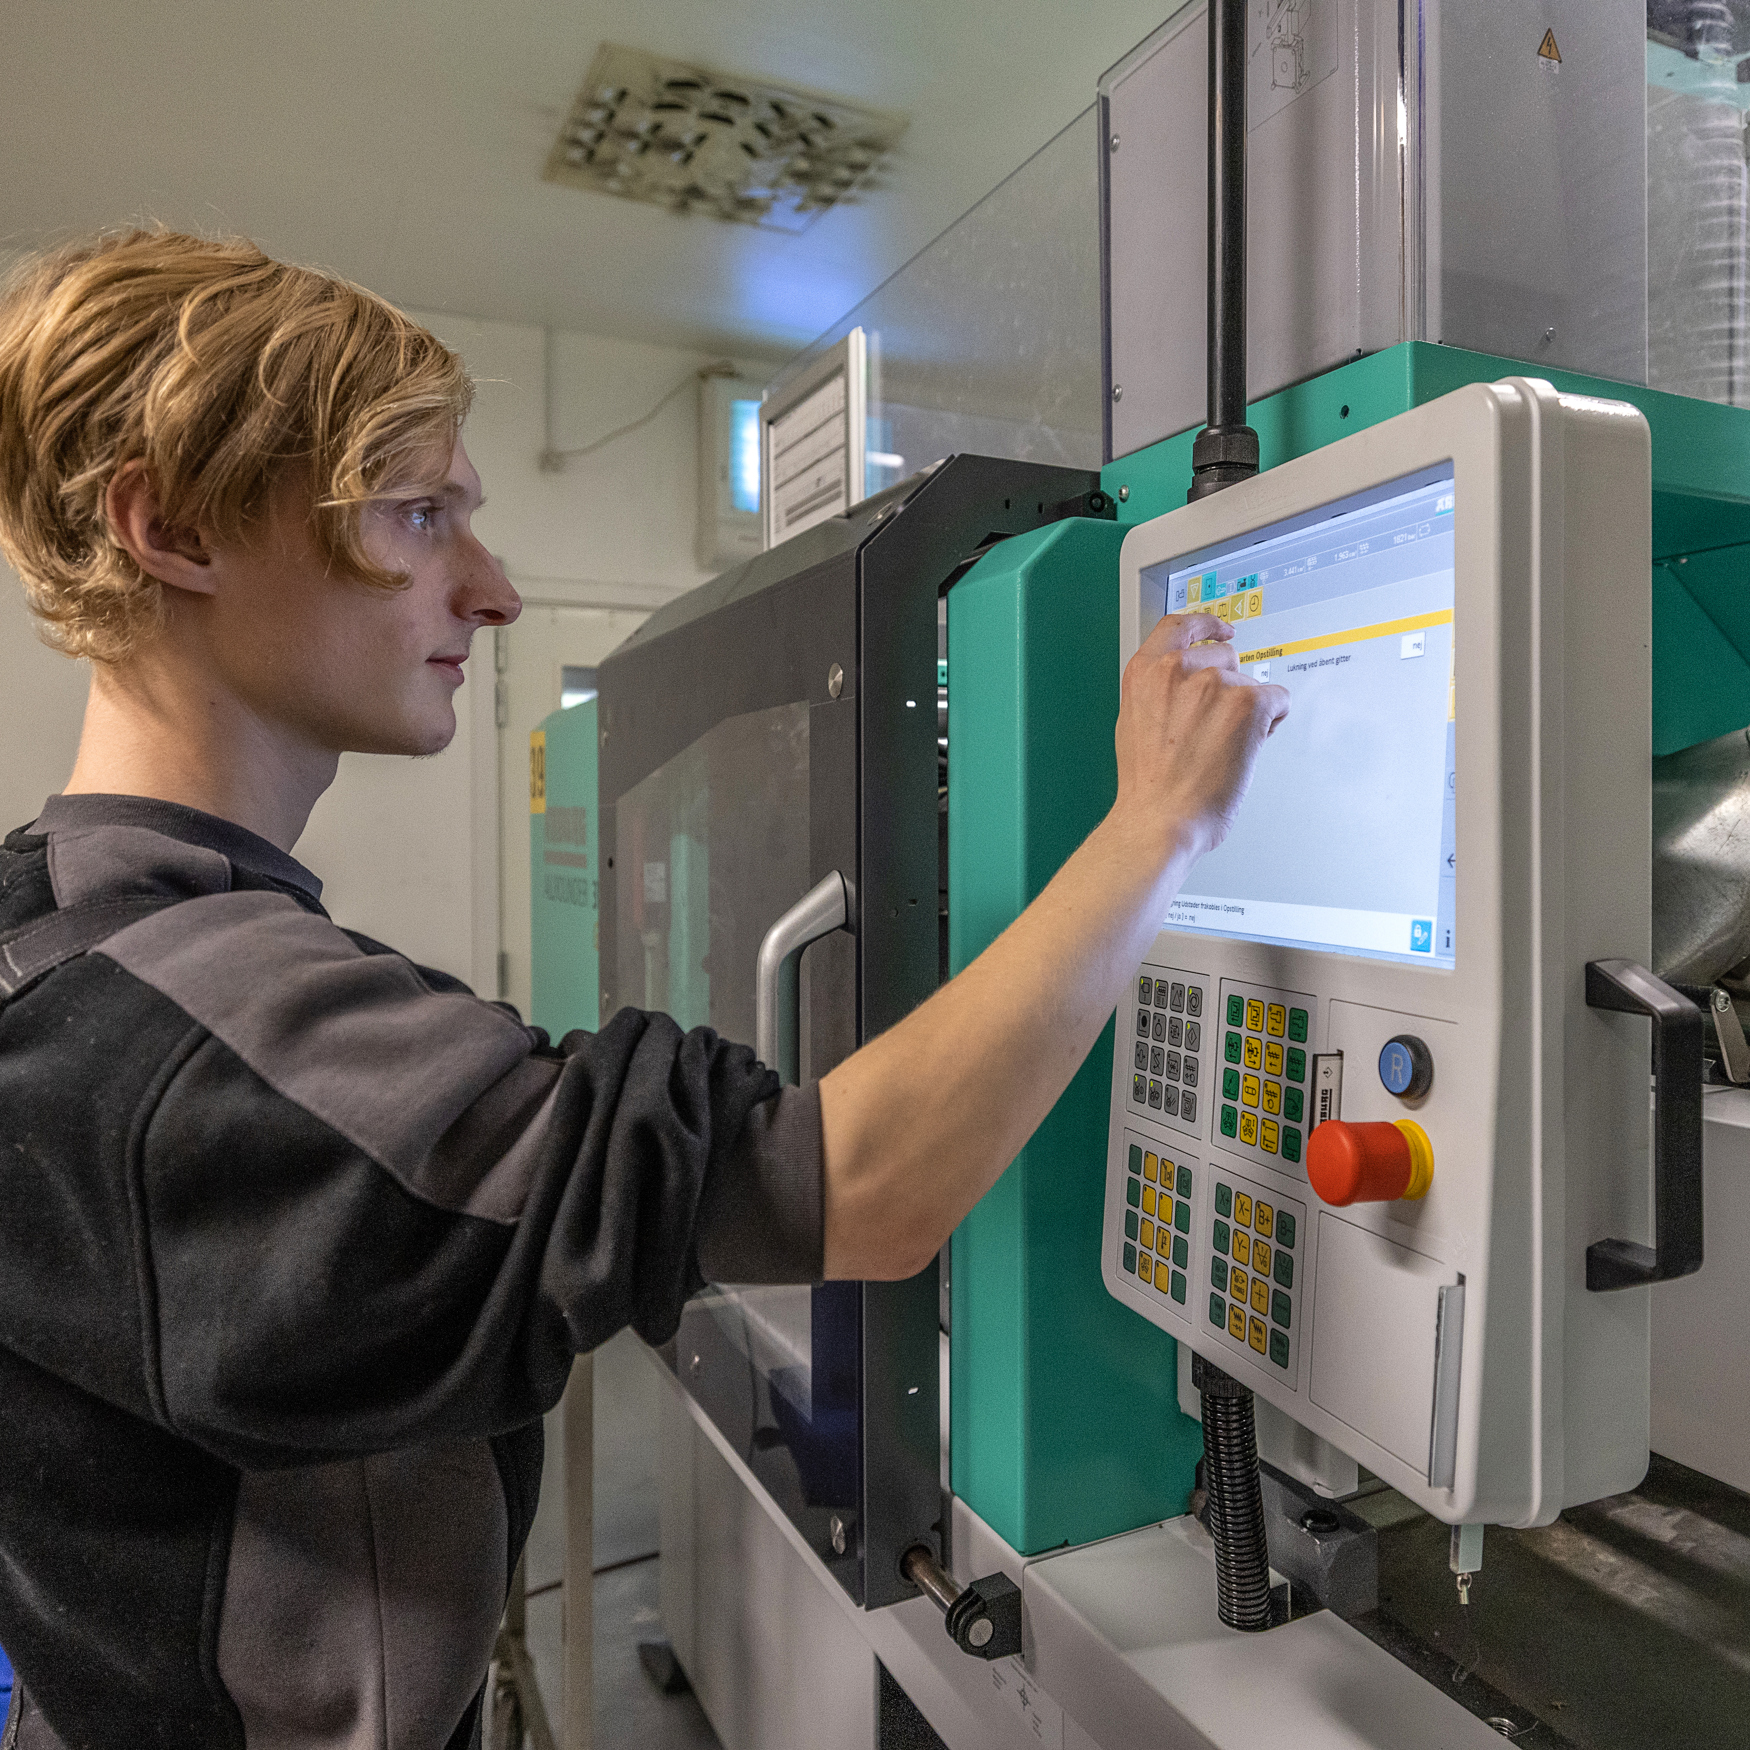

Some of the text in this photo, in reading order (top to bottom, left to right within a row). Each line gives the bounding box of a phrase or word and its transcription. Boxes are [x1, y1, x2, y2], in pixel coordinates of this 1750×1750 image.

[1412, 640, 1422, 651] nej
[1239, 648, 1283, 663] arten Opstilling
[1287, 662, 1307, 673] Lukning
[1308, 659, 1318, 669] ved
[1335, 655, 1352, 666] gitter
[1391, 1052, 1404, 1084] R
[1320, 1088, 1329, 1124] BURG
[1258, 1209, 1271, 1226] B+
